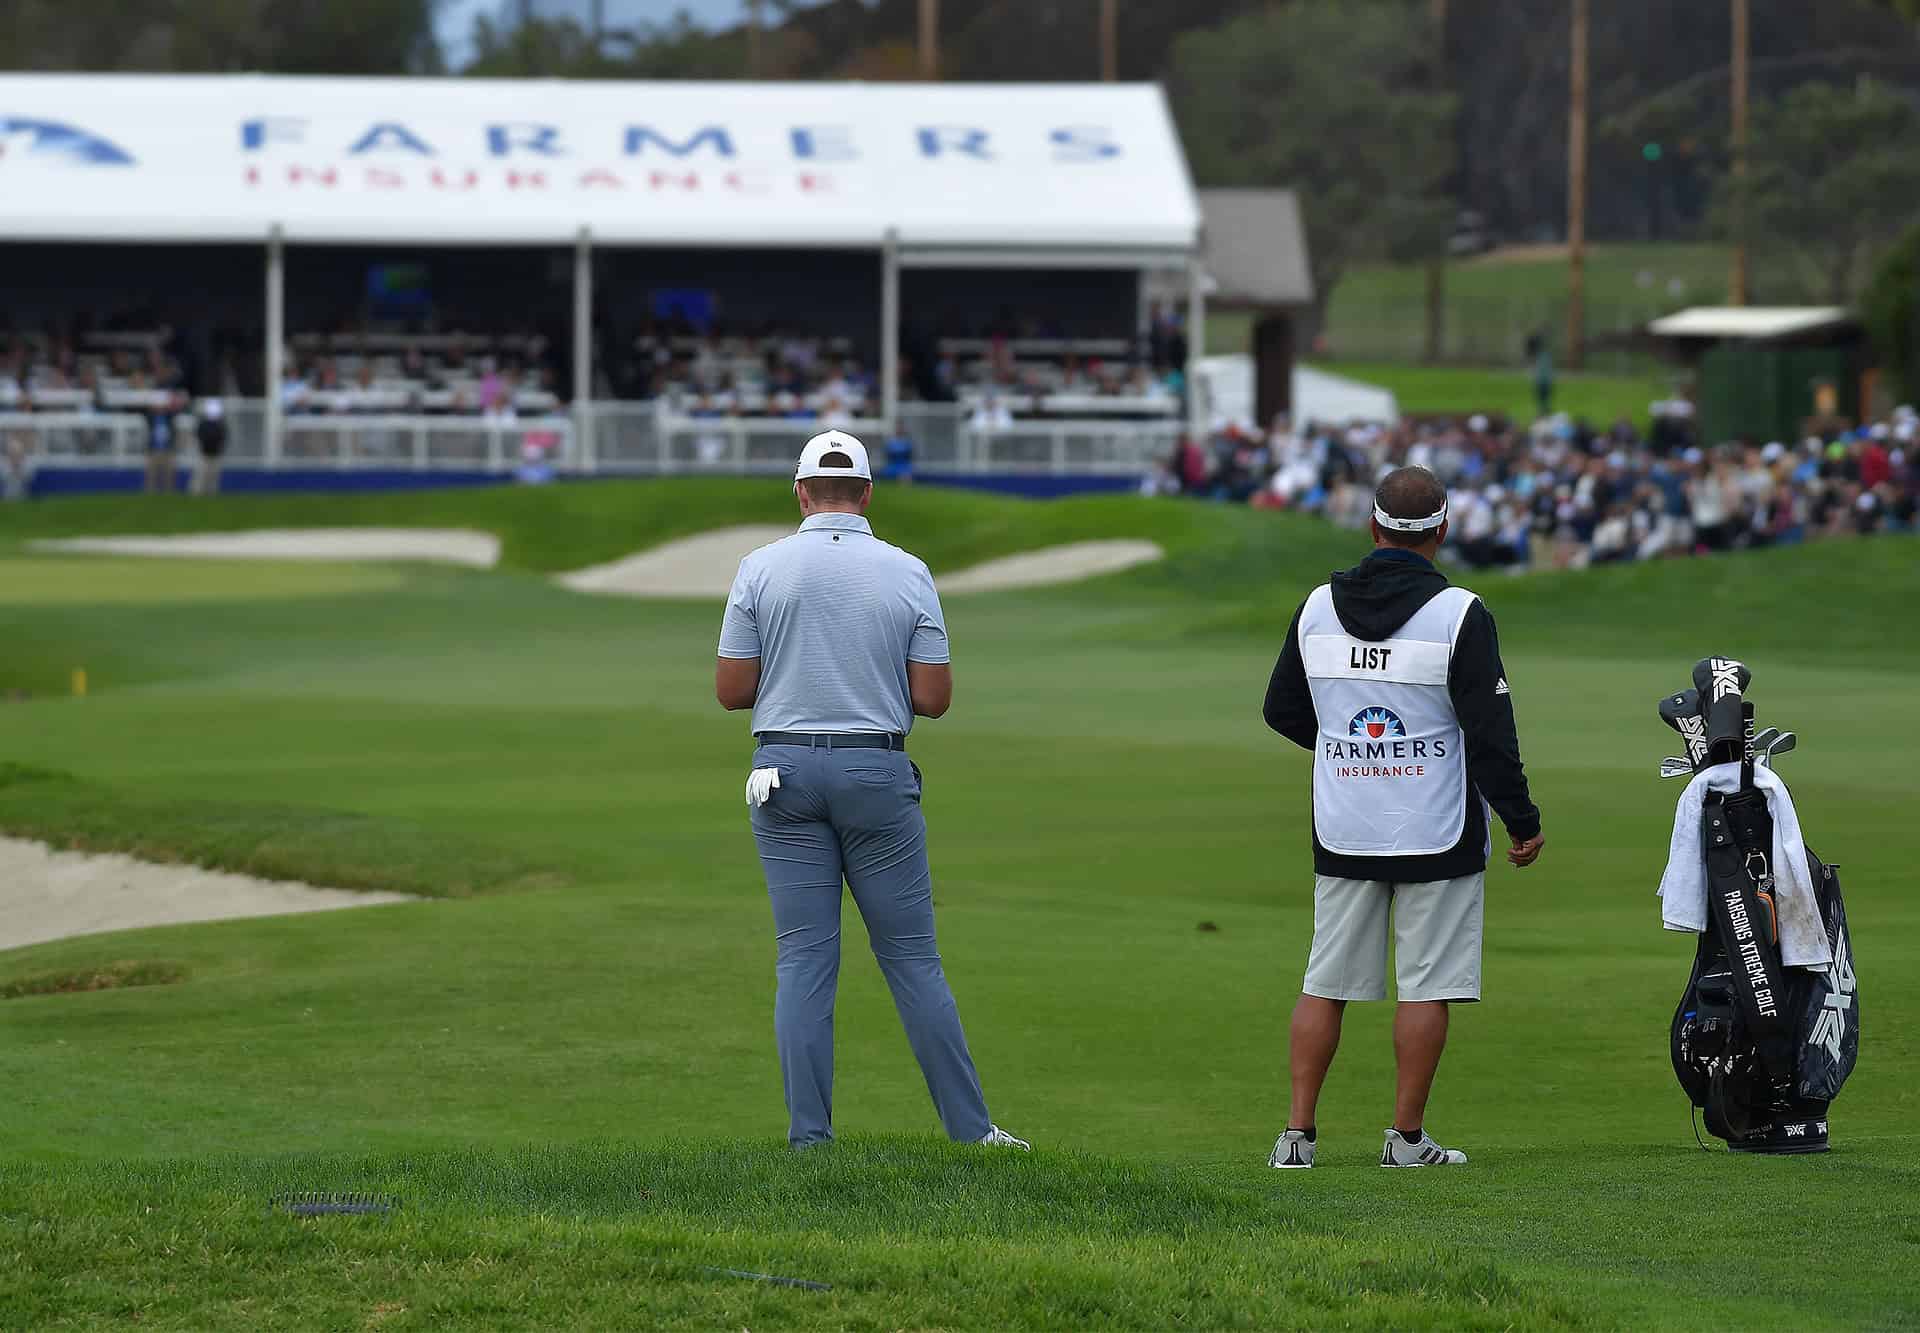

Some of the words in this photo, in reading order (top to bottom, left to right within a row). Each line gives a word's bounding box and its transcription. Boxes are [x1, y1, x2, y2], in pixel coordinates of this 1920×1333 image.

[239, 116, 1123, 163] FARMERS
[244, 166, 836, 192] INSURANCE
[1350, 646, 1392, 671] LIST
[1325, 740, 1447, 761] FARMERS
[1336, 765, 1425, 777] INSURANCE
[1724, 889, 1753, 941] PARSONS
[1739, 940, 1769, 988] XTREME
[1754, 988, 1777, 1017] GOLF
[1784, 1123, 1807, 1137] PXG
